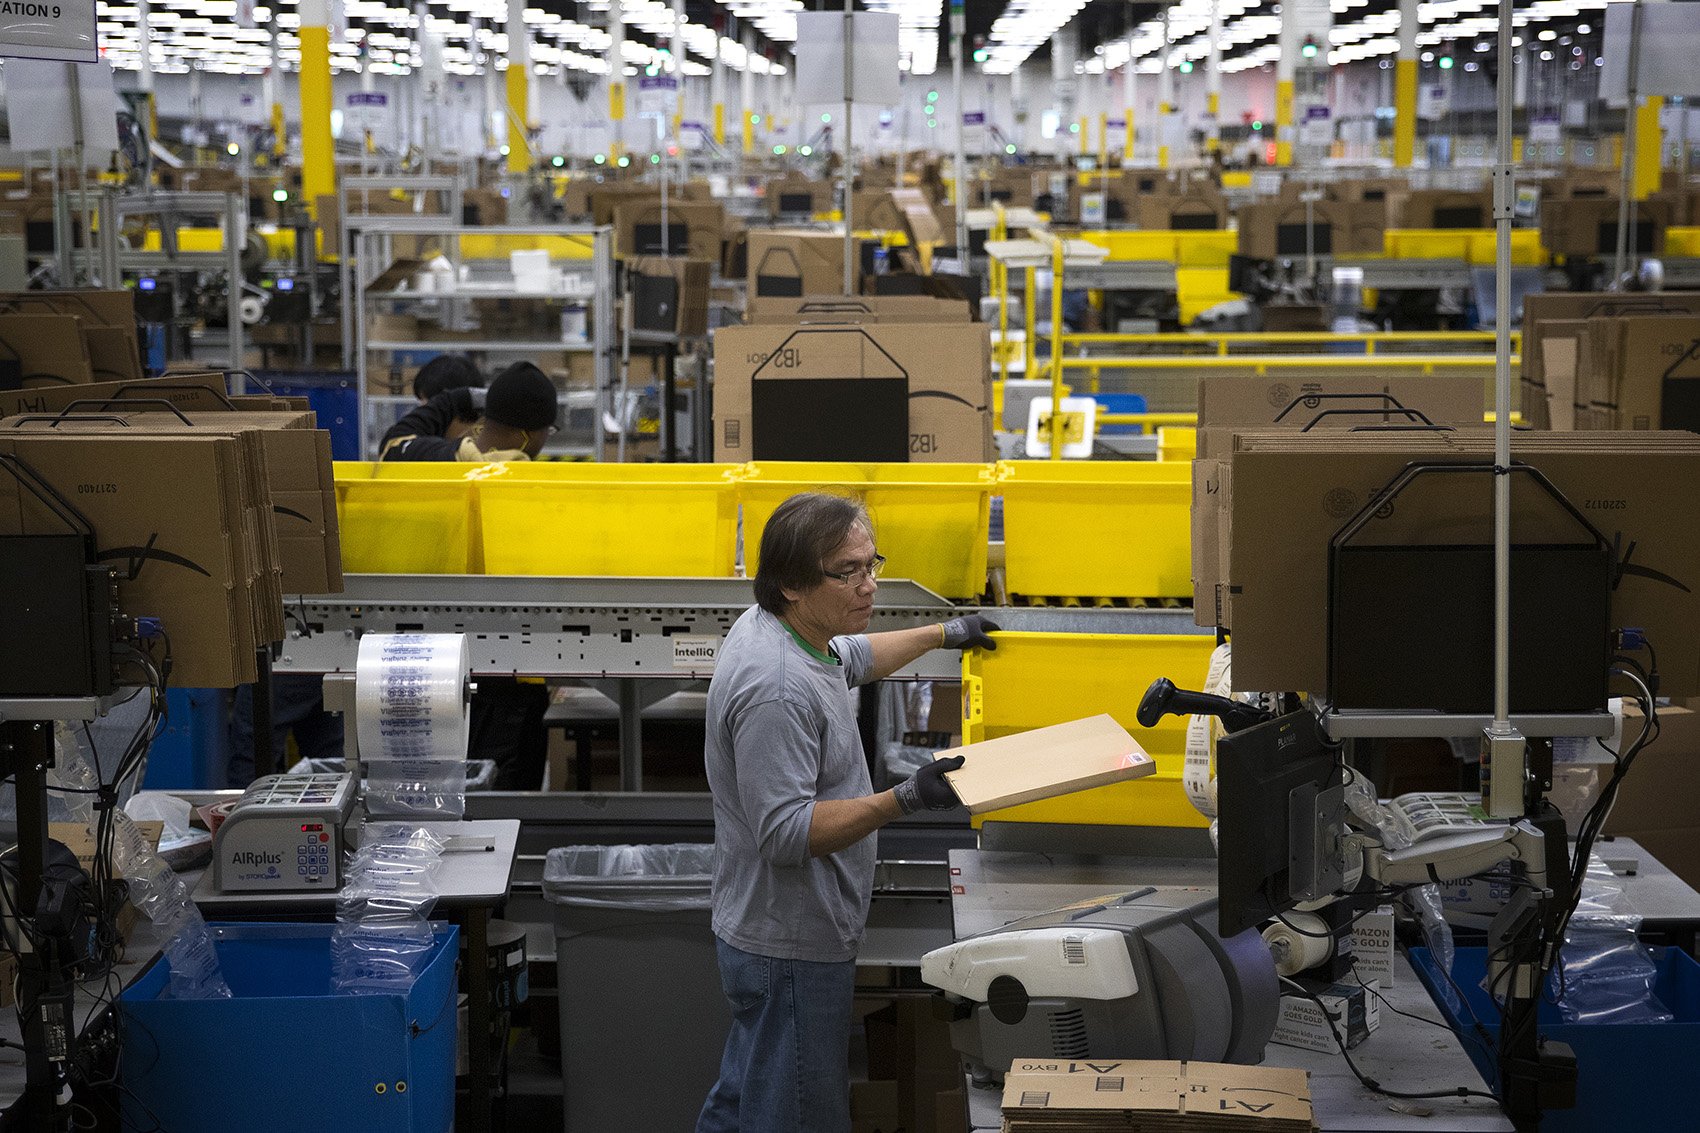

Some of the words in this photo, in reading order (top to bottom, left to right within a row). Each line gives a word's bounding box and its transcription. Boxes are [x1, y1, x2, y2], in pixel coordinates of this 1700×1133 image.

[0, 1, 48, 17] ATION
[52, 6, 61, 18] 9
[774, 349, 802, 367] 1B2
[910, 434, 938, 453] 1B2
[78, 483, 117, 494] S217400
[1585, 499, 1627, 510] S220172
[675, 647, 715, 658] IntelliQ
[232, 851, 282, 868] AIRplus
[1360, 938, 1390, 948] GOLD
[1283, 1010, 1302, 1020] GOES
[1303, 1014, 1323, 1024] GOLD
[1293, 1005, 1323, 1017] AMAZON
[1274, 1031, 1289, 1041] fight
[1289, 1036, 1309, 1044] cancer
[1310, 1040, 1330, 1049] alone.
[1275, 1026, 1299, 1036] because
[1301, 1030, 1313, 1038] kids
[1314, 1034, 1330, 1042] can't
[1069, 1062, 1122, 1074] A1
[1219, 1099, 1275, 1113] A1
